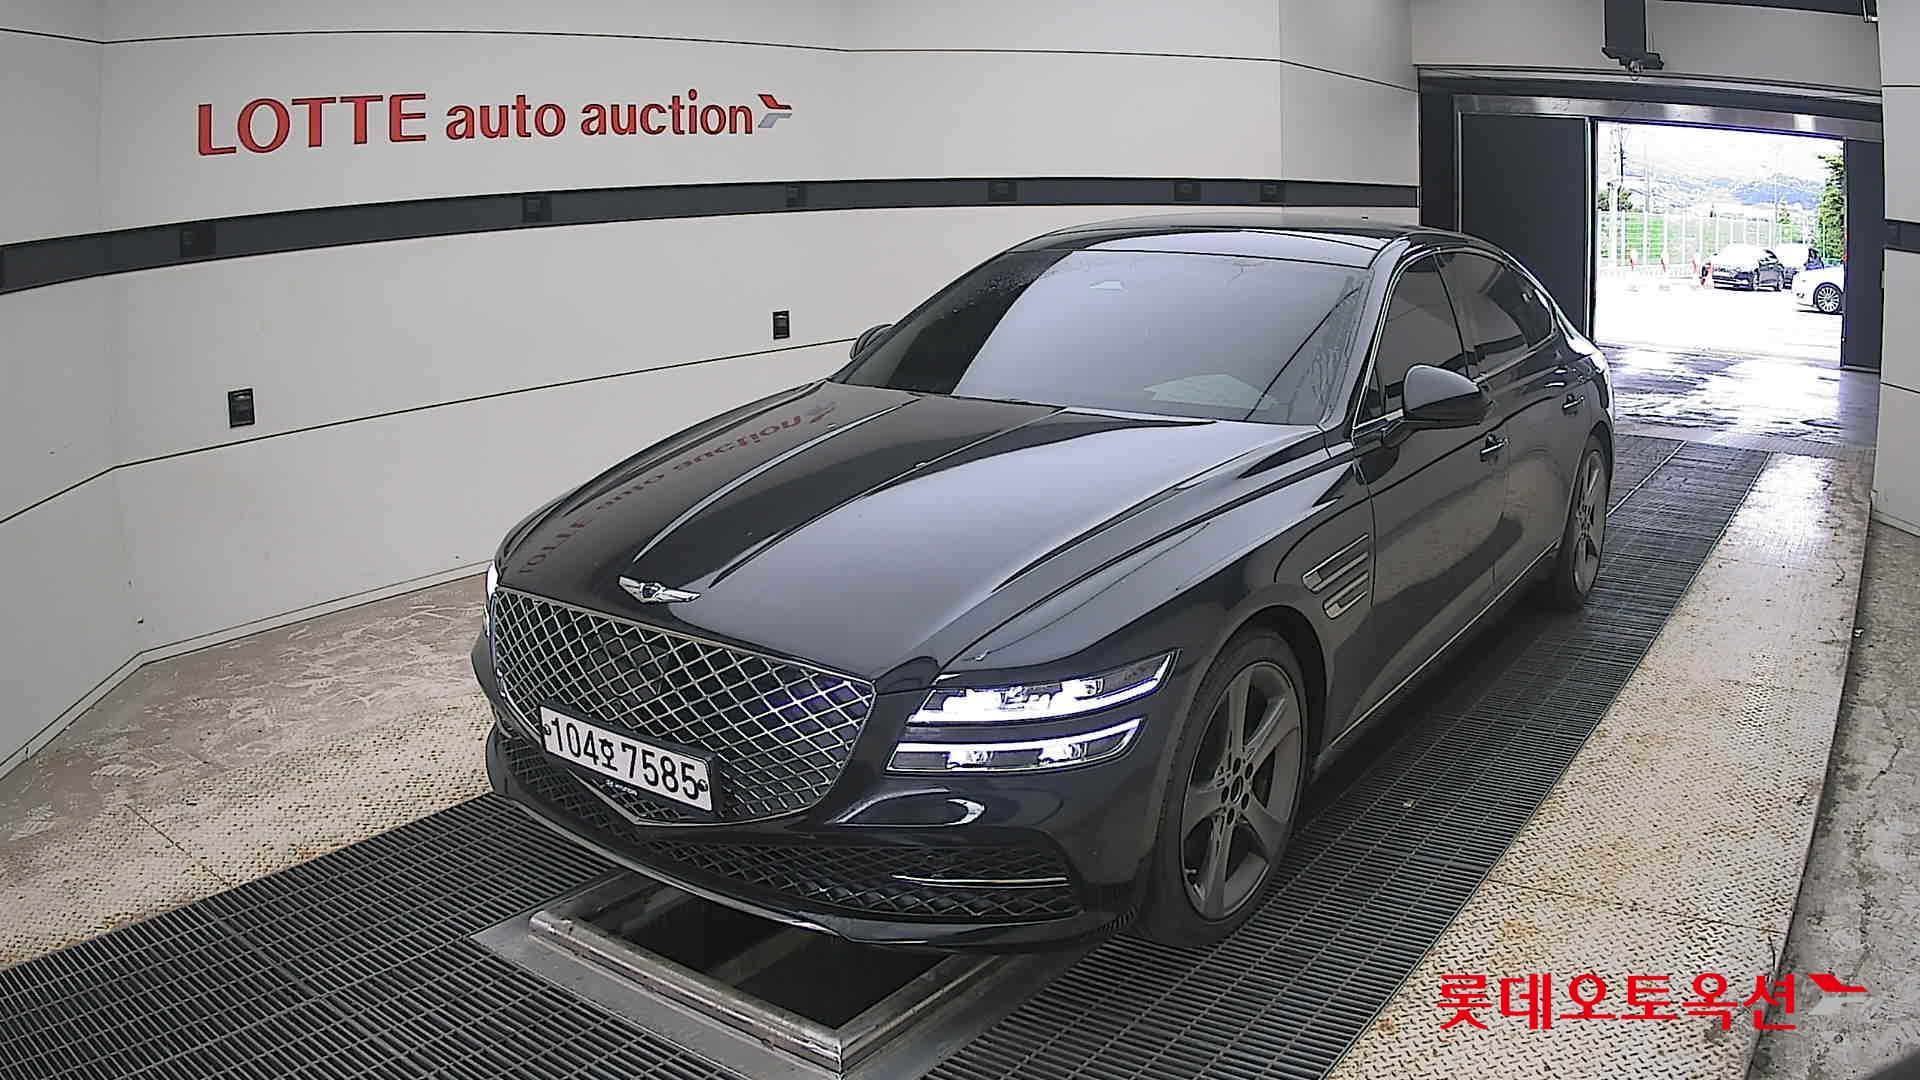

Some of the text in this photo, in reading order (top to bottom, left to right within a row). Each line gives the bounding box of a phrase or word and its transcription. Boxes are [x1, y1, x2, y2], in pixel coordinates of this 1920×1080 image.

[198, 88, 753, 156] LOTTE auto auction
[551, 717, 700, 800] 104호 7585
